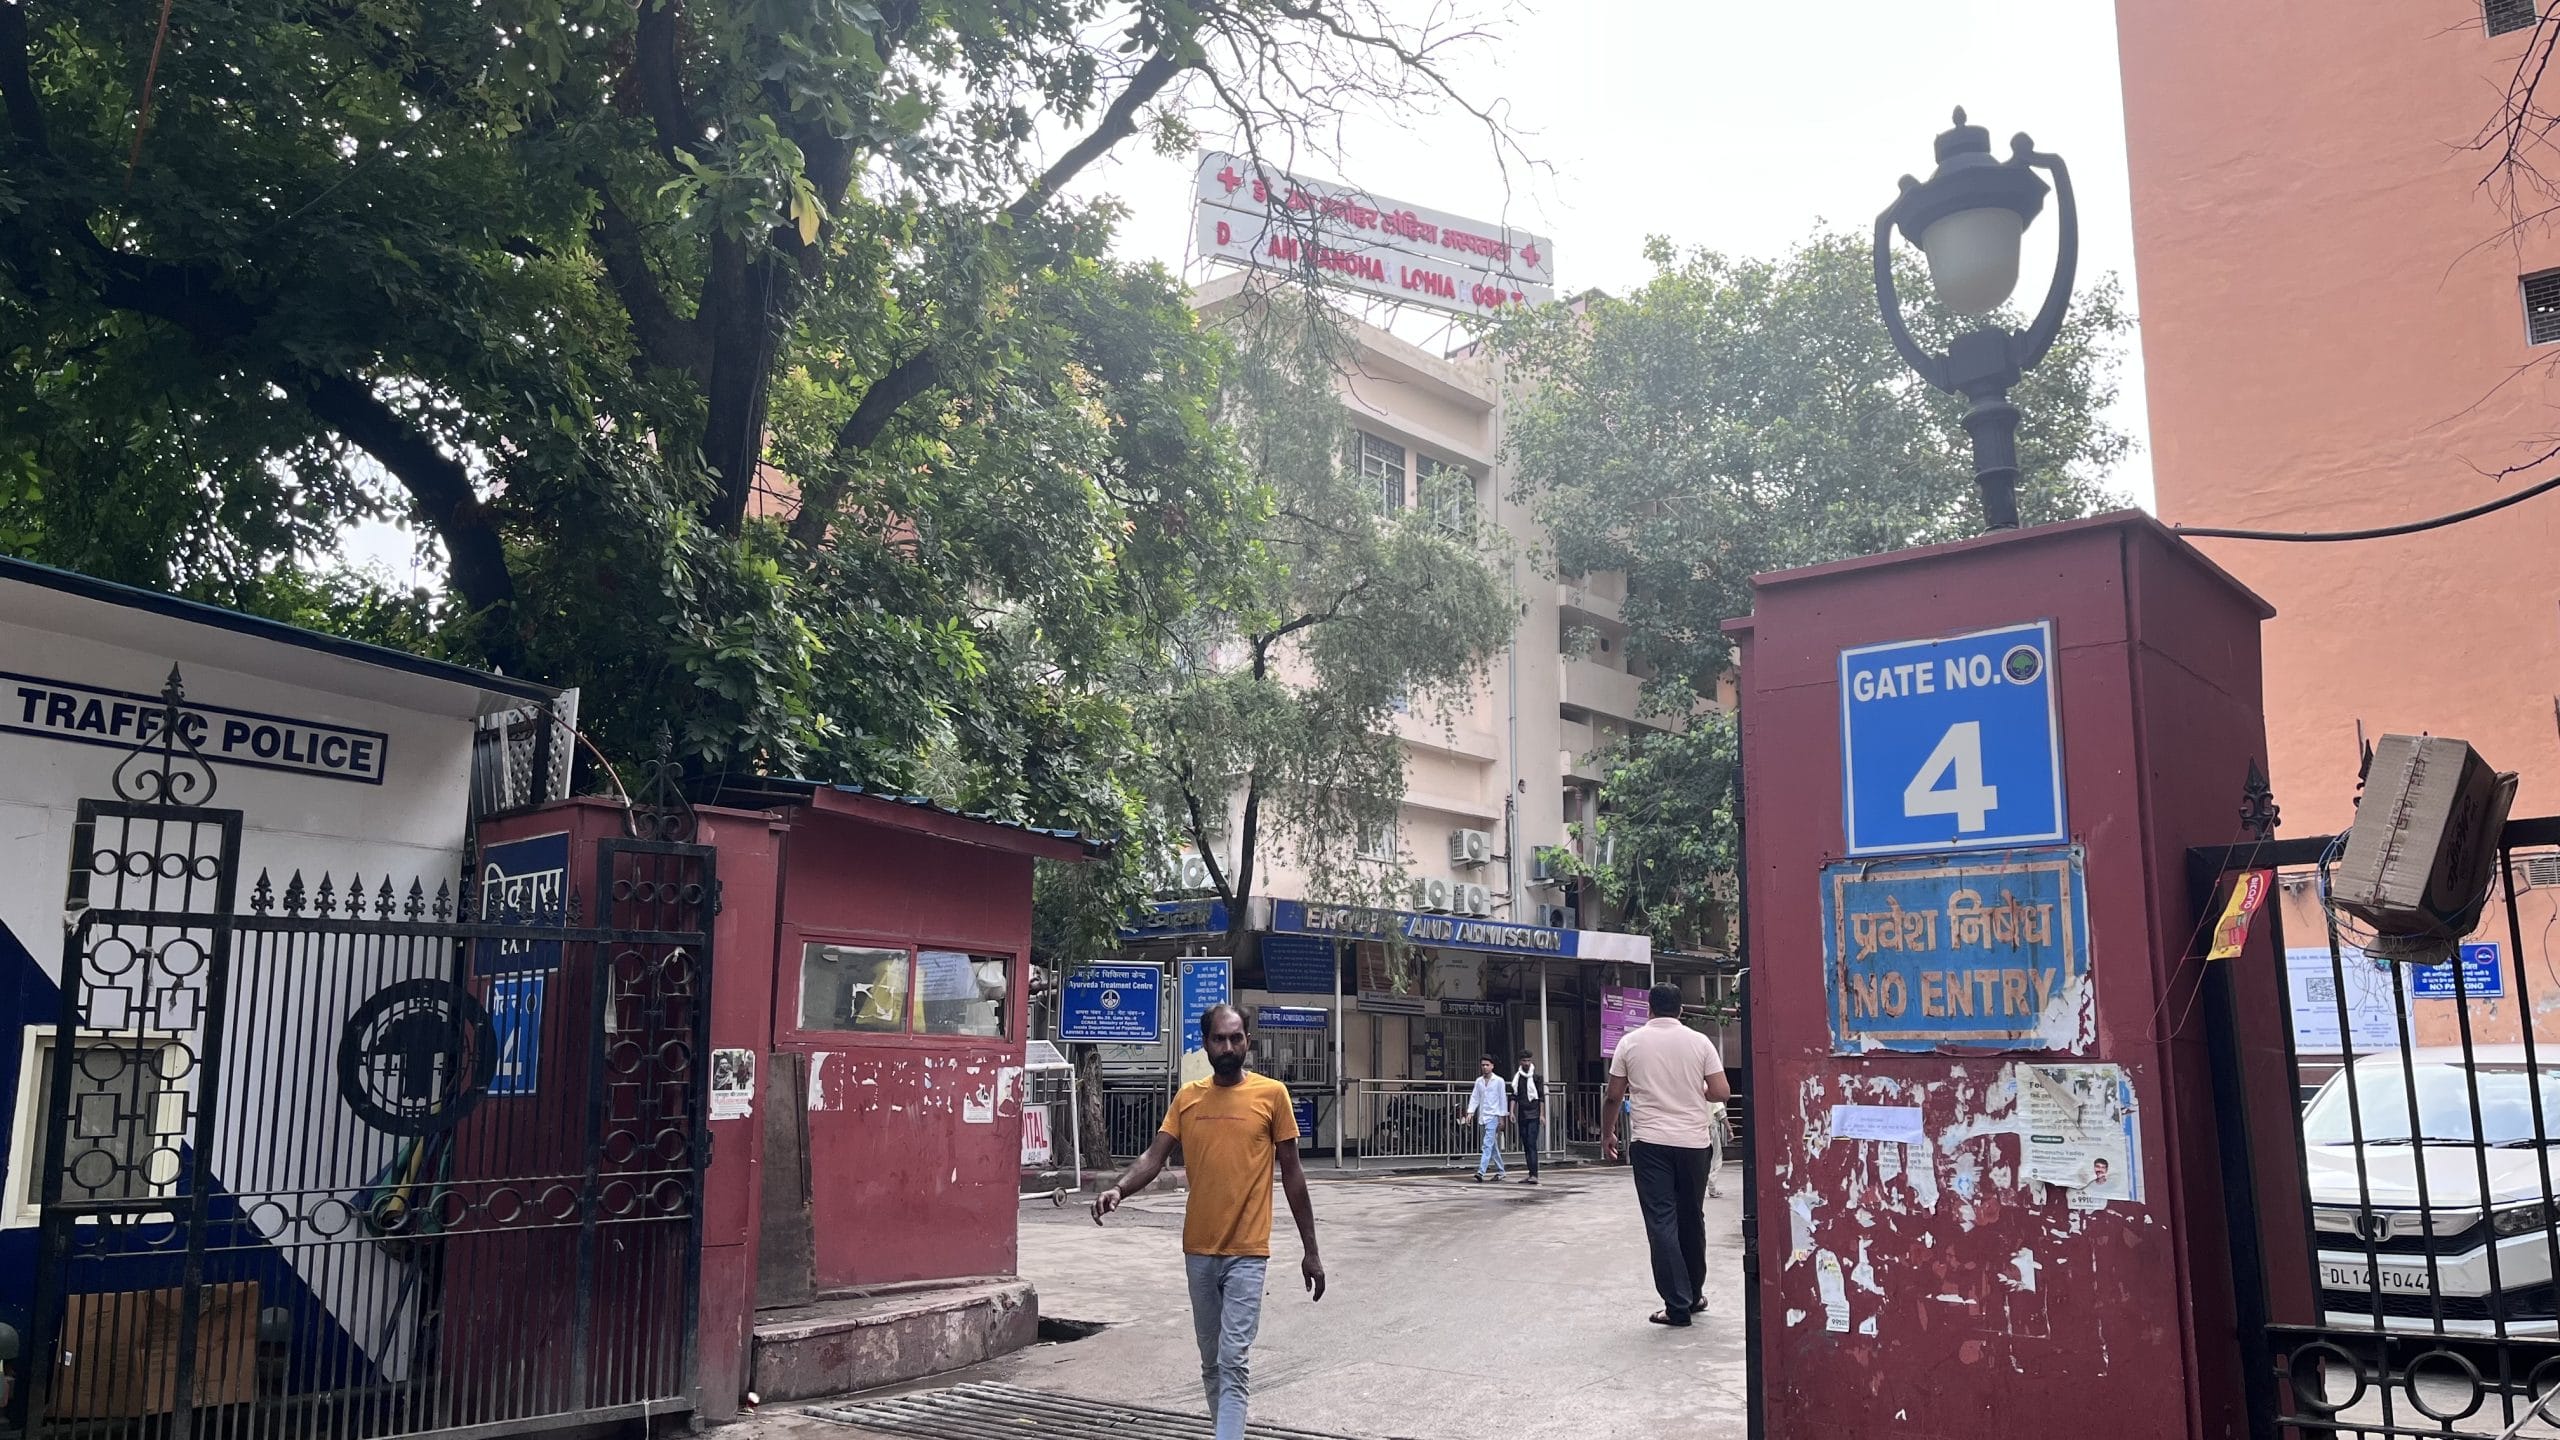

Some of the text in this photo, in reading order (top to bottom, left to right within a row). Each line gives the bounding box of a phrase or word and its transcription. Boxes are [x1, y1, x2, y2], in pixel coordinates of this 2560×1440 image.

[1381, 209, 1439, 245] लोहिया
[1441, 228, 1512, 262] अस्पताल
[1401, 265, 1456, 300] LOHIA
[1853, 653, 2001, 702] GATE NO.
[17, 686, 374, 773] TRAFFC POLICE
[1903, 719, 1999, 833] 4
[1407, 916, 1454, 941] AND
[1455, 921, 1561, 951] ADMISSION
[1850, 888, 2054, 963] प्रवेश निषेध
[1069, 981, 1154, 990] Ayurveda Treatment Centre
[1102, 969, 1130, 979] चिकित्सा
[1851, 966, 2058, 1019] NO ENTRY
[2445, 982, 2484, 990] PAKING
[1021, 1111, 1048, 1149] ITAL
